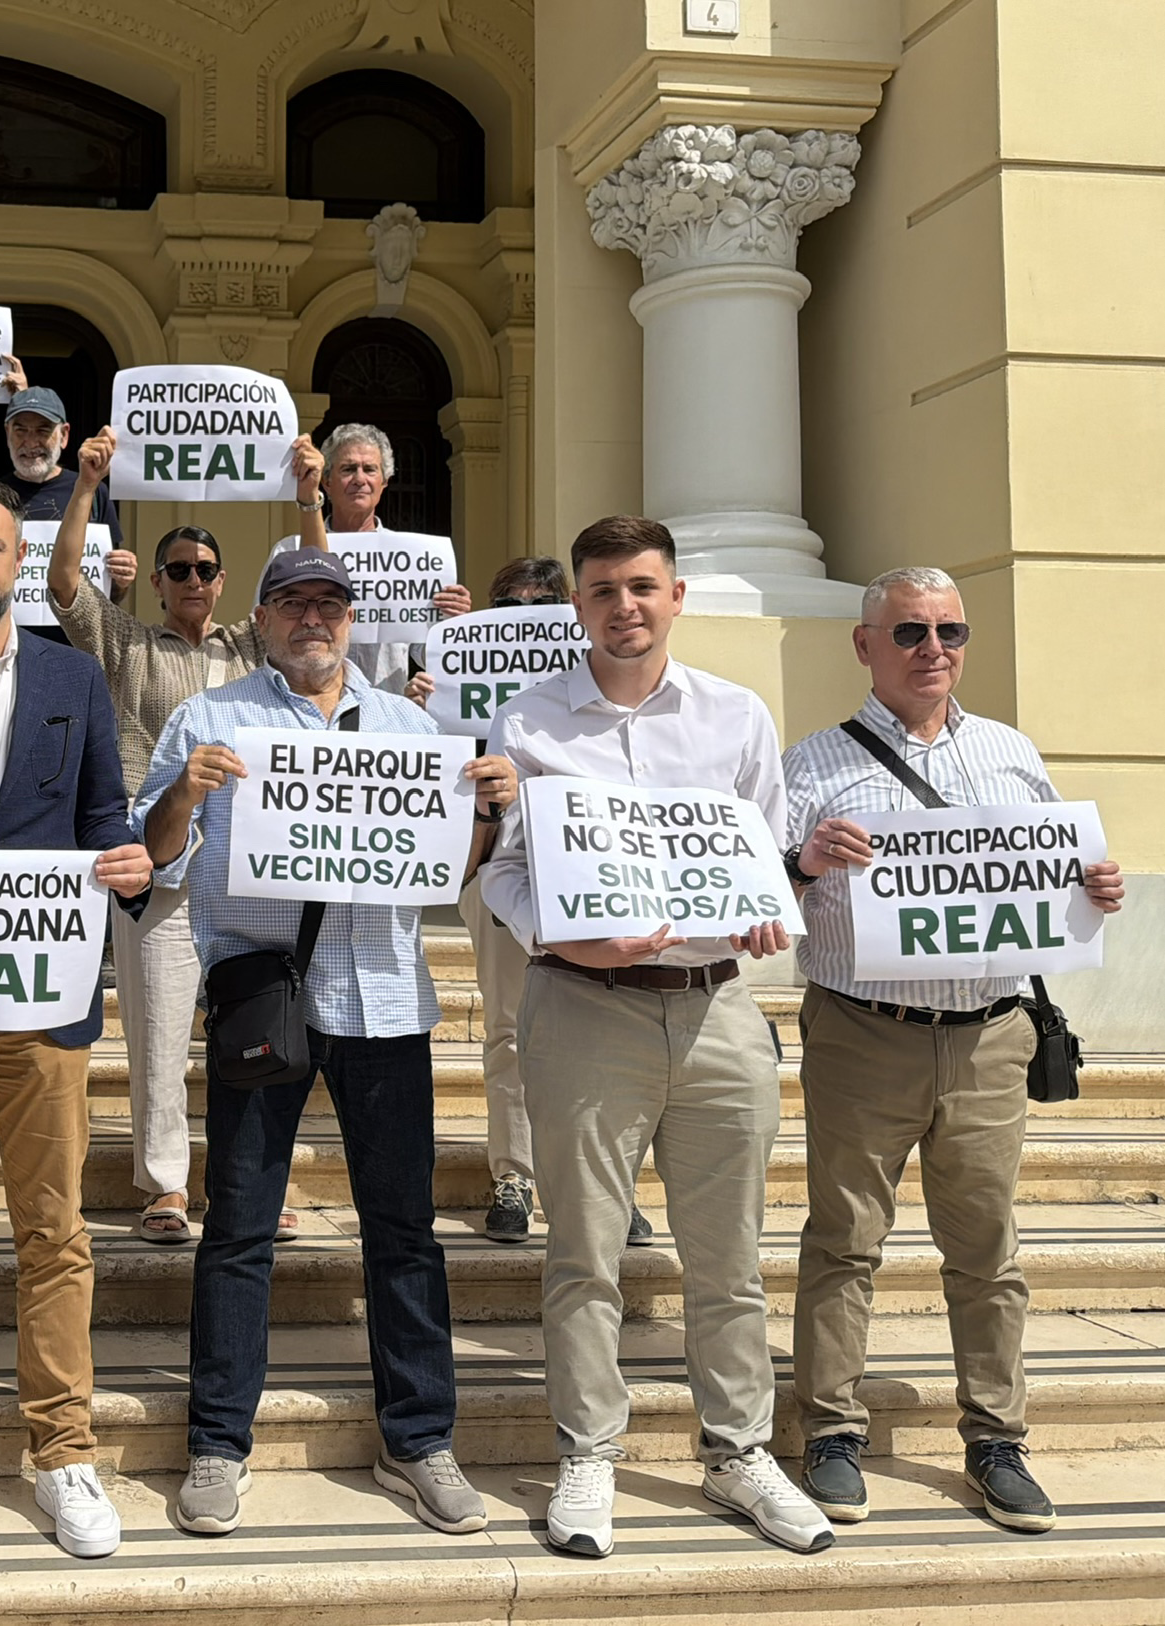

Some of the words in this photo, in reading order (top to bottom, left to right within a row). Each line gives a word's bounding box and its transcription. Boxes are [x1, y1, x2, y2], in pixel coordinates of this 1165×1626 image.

[707, 3, 718, 25] 4
[127, 380, 277, 404] PARTICIPACIÓN
[127, 410, 283, 436] CIUDADANA
[144, 444, 265, 480] REAL
[416, 551, 443, 571] de
[369, 608, 396, 623] DEL
[399, 607, 443, 622] OESTE
[442, 648, 586, 675] CIUDADAN
[270, 744, 304, 774] EL
[313, 747, 441, 781] PARQUE
[262, 781, 308, 811] NO
[316, 783, 353, 813] SE
[361, 786, 446, 818] TOCA
[567, 791, 603, 819] EL
[608, 797, 739, 827] PARQUE
[289, 823, 341, 850] SIN
[352, 826, 415, 854] LOS
[563, 825, 610, 852] NO
[620, 829, 656, 858] SE
[660, 832, 755, 859] TOCA
[870, 817, 1079, 857] PARTICIPACIÓN
[248, 854, 450, 889] VECINOS/AS
[598, 863, 654, 889] SIN
[662, 867, 732, 892] LOS
[871, 858, 1086, 899] CIUDADANA
[558, 893, 781, 920] VECINOS/AS
[899, 901, 1064, 956] REAL
